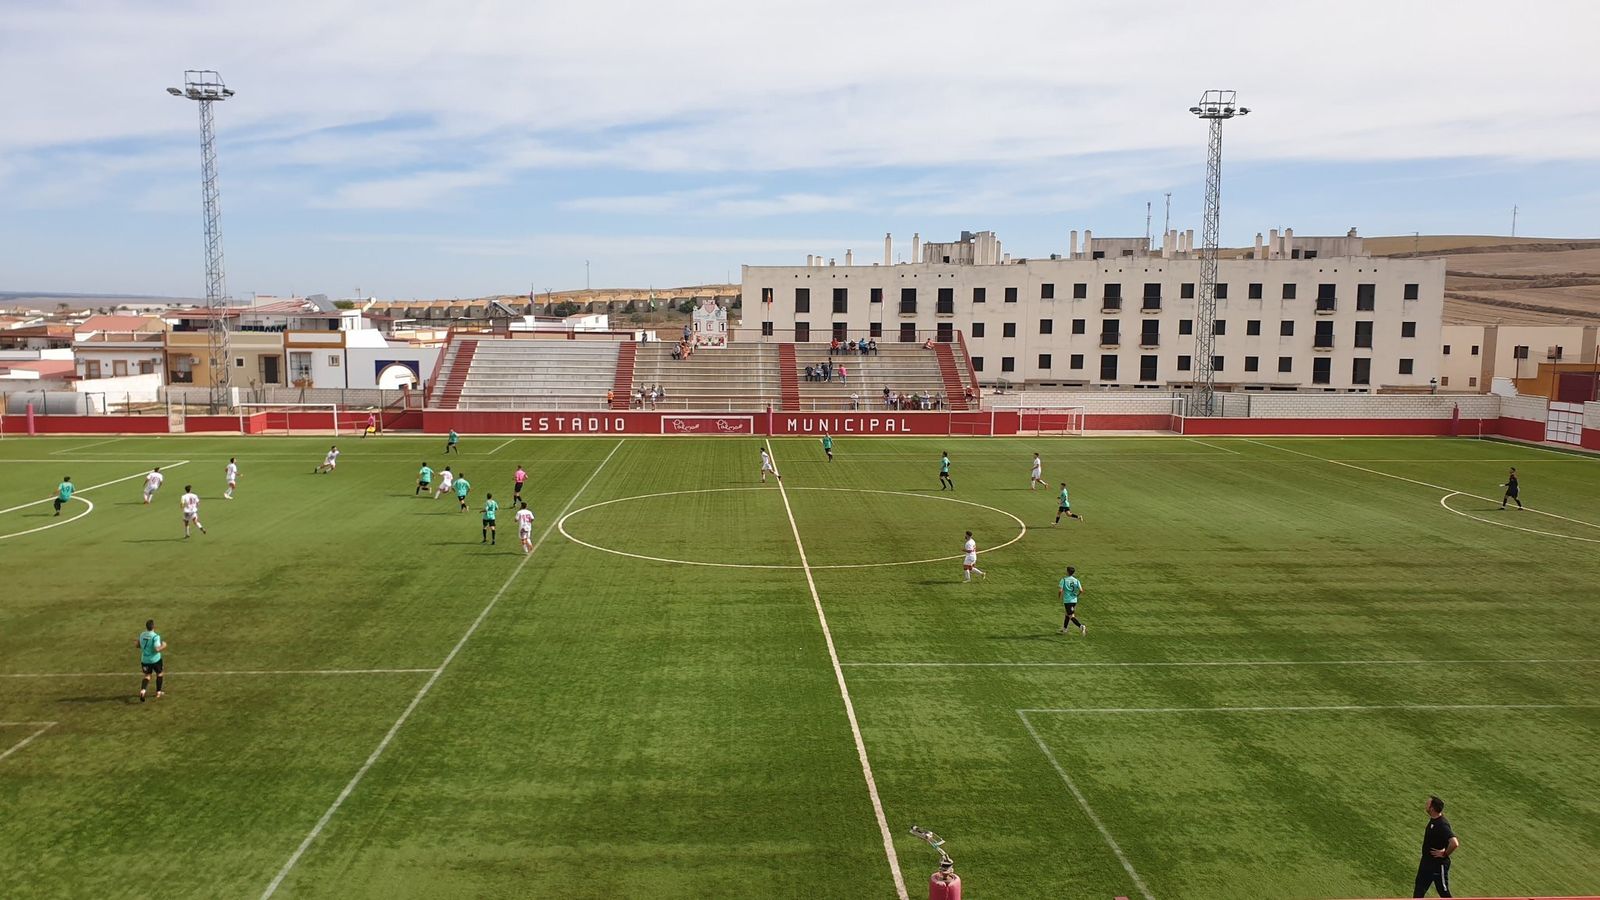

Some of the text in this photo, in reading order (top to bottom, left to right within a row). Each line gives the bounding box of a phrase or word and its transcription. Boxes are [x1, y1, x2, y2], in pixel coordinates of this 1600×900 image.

[522, 418, 625, 431] ESTADIO
[787, 418, 911, 432] MUNICIPAL
[143, 637, 151, 650] 7
